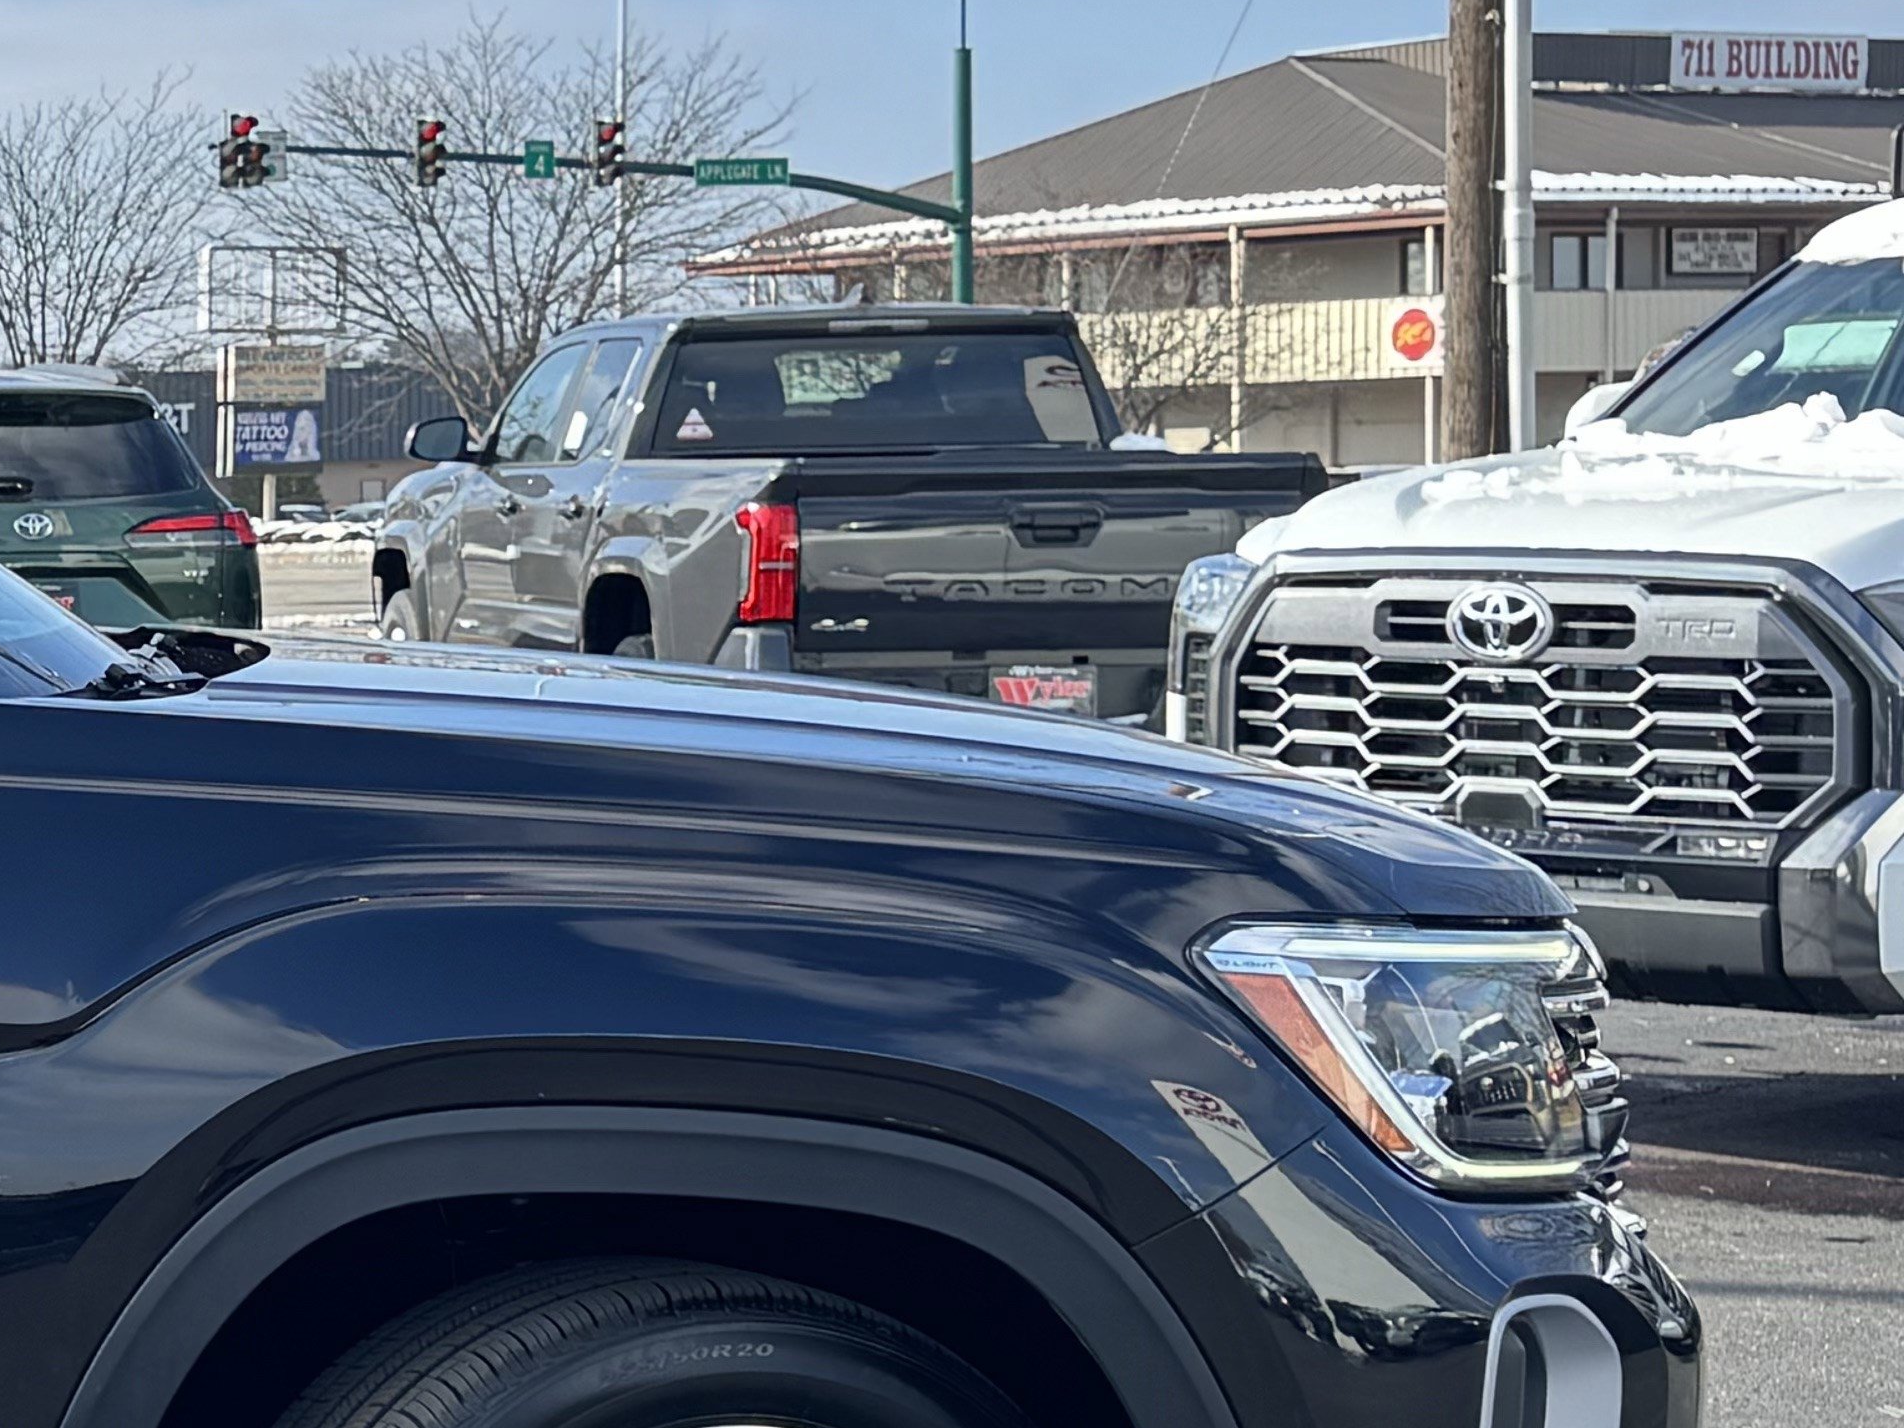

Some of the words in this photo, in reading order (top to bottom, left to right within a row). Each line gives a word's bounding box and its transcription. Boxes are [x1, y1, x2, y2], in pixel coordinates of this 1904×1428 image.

[1681, 39, 1716, 78] 711
[1725, 39, 1859, 80] BUILDING
[533, 153, 546, 174] 4
[699, 164, 760, 180] APPLEGATE
[235, 425, 289, 442] TATTOO
[1656, 618, 1736, 644] TRD
